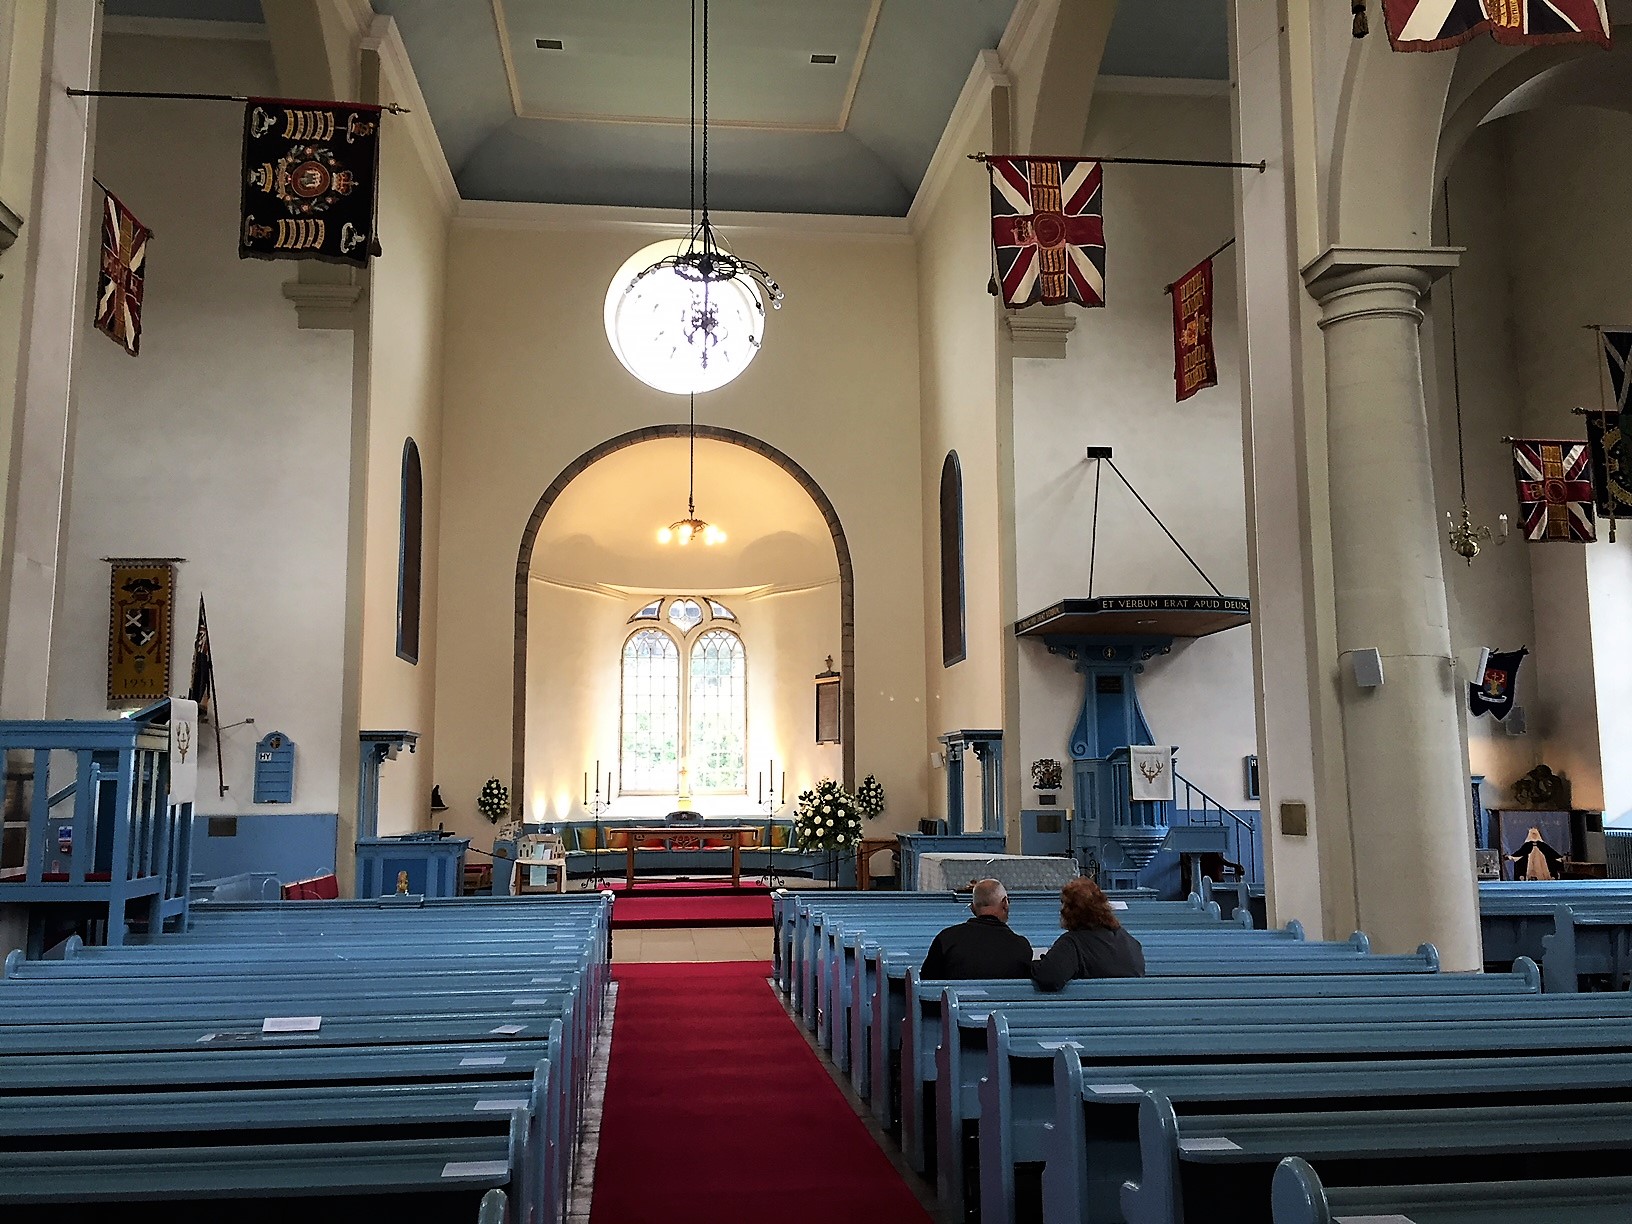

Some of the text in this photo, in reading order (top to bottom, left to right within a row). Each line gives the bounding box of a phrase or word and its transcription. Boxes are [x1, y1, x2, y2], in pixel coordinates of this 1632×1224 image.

[1102, 600, 1114, 609] ET
[1118, 599, 1158, 608] VERBUM
[1164, 599, 1188, 608] ERAT
[1193, 599, 1220, 608] APUD
[259, 752, 271, 760] HY
